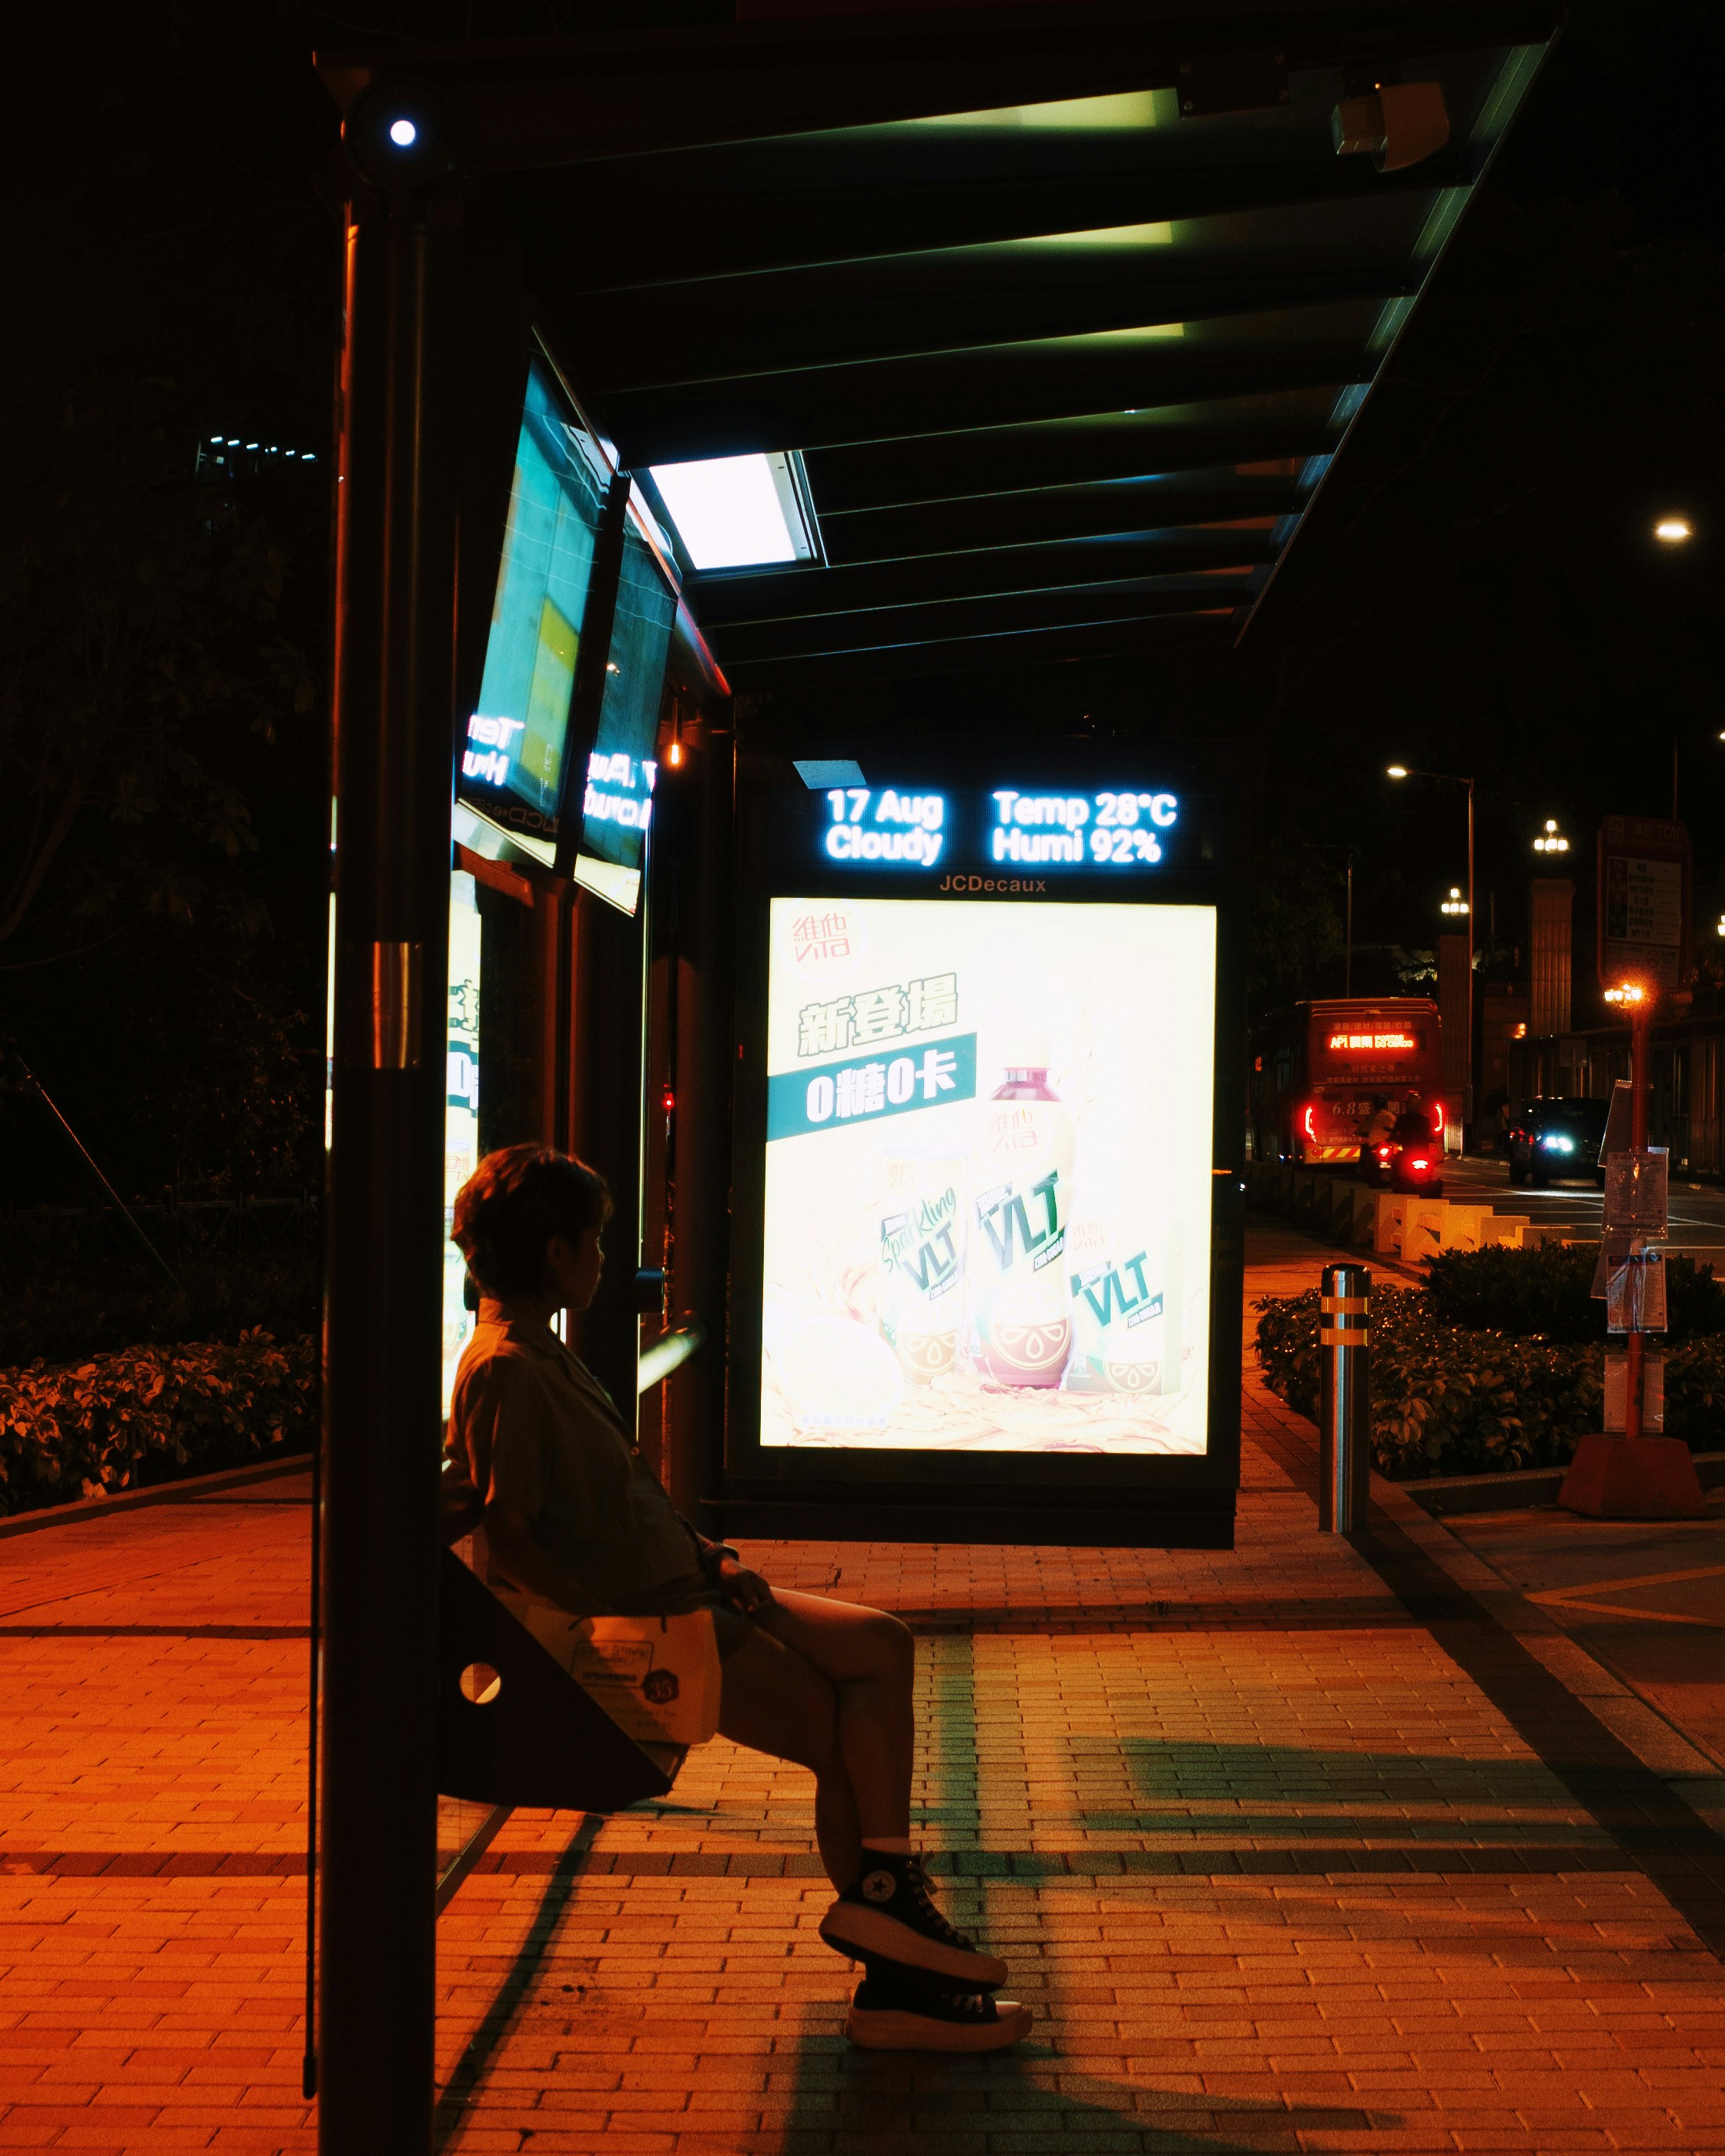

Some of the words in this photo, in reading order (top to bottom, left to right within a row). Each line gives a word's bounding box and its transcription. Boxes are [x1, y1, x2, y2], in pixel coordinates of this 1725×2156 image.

[827, 790, 869, 822] 17
[876, 790, 943, 829] Aug
[993, 792, 1090, 831] Temp
[1095, 793, 1177, 826] 28°C
[826, 825, 943, 865] Cloudy
[993, 829, 1084, 862] Humi
[1090, 829, 1161, 863] 92%
[1657, 825, 1680, 839] TCM
[939, 875, 1047, 892] JCDecaux
[792, 912, 849, 941] 維他
[797, 972, 958, 1058] 新登場
[806, 1049, 956, 1123] 0糖0卡
[881, 1186, 956, 1274] Sparkling
[983, 1168, 1060, 1270] VLT
[901, 1220, 958, 1291] VLT
[1084, 1250, 1148, 1327] VLT
